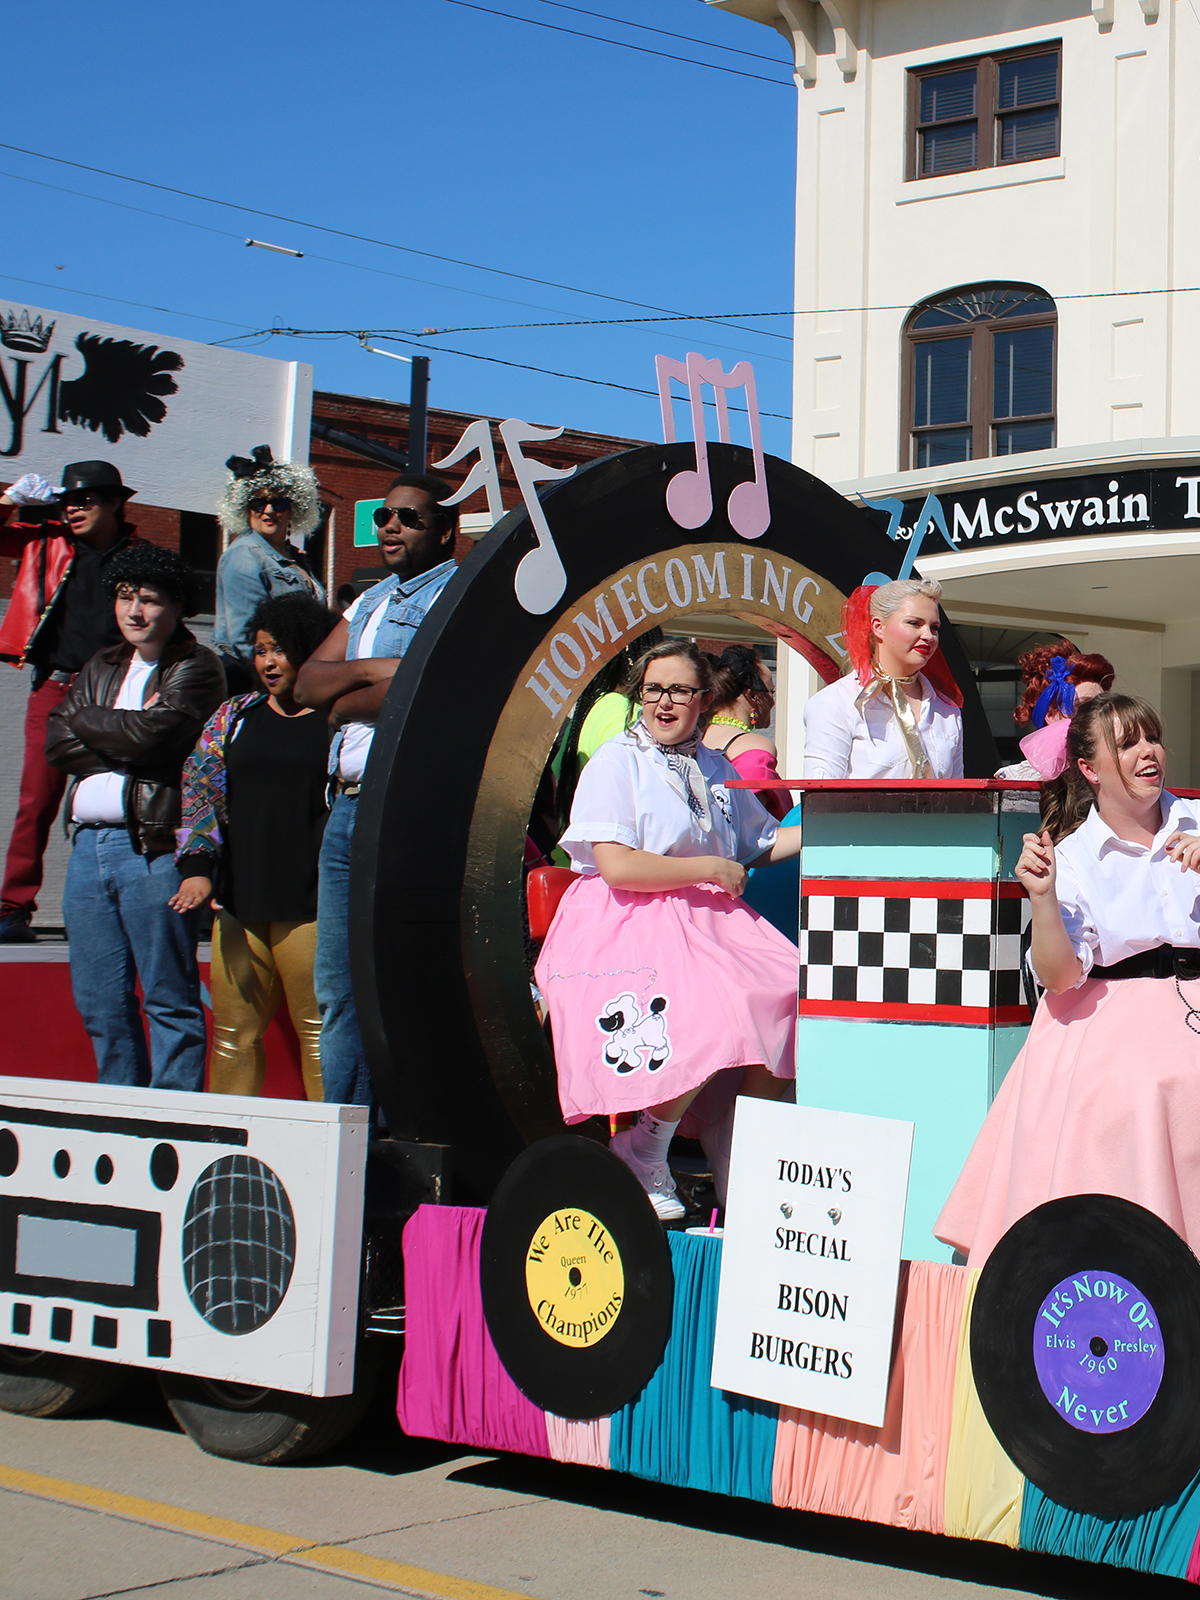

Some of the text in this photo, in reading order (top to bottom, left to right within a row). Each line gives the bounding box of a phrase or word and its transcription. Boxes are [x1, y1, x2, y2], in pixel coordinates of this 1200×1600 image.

[951, 478, 1150, 543] McSwain
[525, 551, 822, 720] HOMECOMING
[777, 1158, 852, 1193] TODAY'S
[529, 1213, 614, 1265] We Are The
[774, 1226, 852, 1261] SPECIAL
[560, 1255, 587, 1268] Queen
[563, 1282, 589, 1301] 1977
[776, 1283, 849, 1322] BISON
[1041, 1275, 1154, 1331] It's Now Or
[537, 1291, 622, 1343] Champions
[749, 1331, 853, 1380] BURGERS
[1046, 1333, 1157, 1358] Elvis Presley
[1078, 1353, 1118, 1374] 1960
[1055, 1385, 1129, 1427] Never
